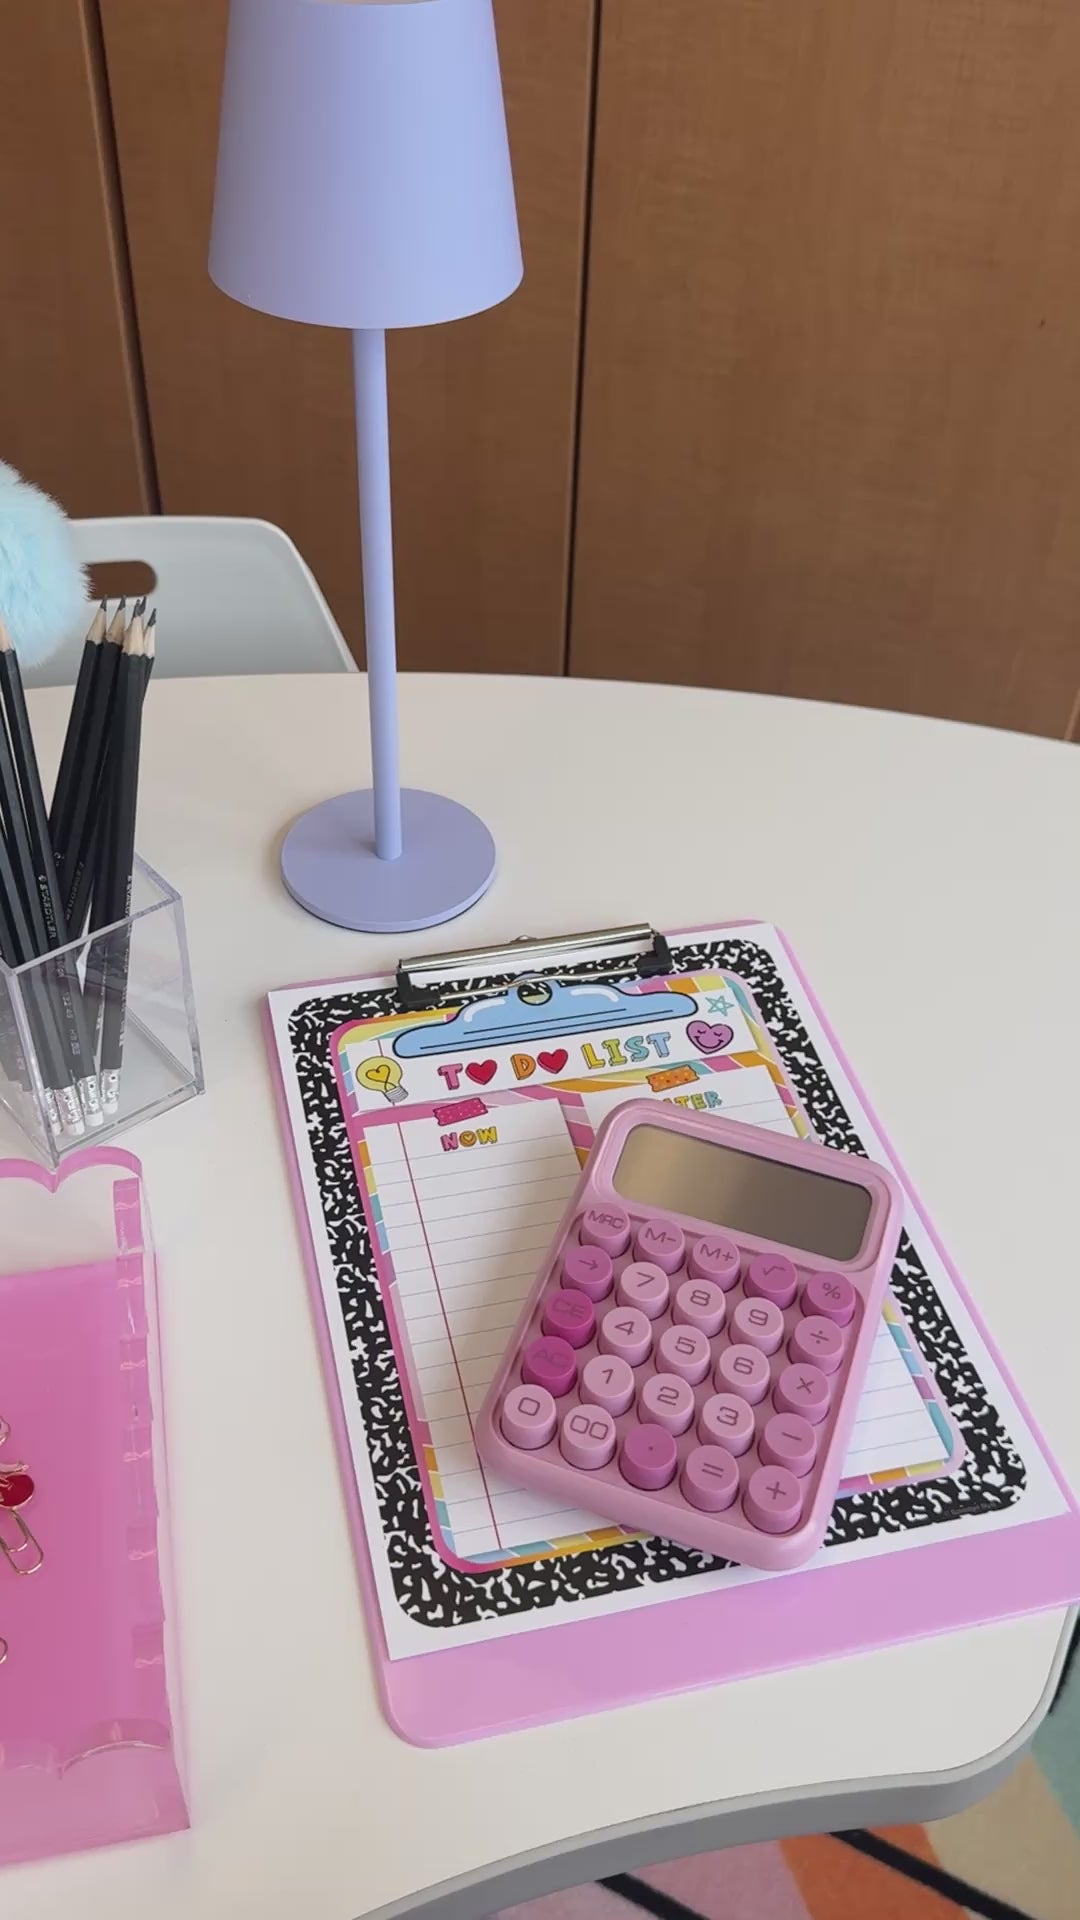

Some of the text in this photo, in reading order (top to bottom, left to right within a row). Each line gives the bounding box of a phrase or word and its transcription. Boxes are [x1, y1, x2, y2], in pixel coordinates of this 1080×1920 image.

[581, 1031, 671, 1069] LIST
[440, 1126, 498, 1151] NOW
[587, 1209, 625, 1230] MRC
[699, 1243, 734, 1262] M+
[636, 1271, 655, 1287] 7
[689, 1289, 711, 1307] 8
[821, 1281, 841, 1300] %
[552, 1299, 586, 1319] CE
[748, 1308, 769, 1326] 9
[615, 1320, 635, 1336] 4
[674, 1336, 697, 1355] 5
[533, 1350, 570, 1371] AC
[733, 1356, 754, 1375] 6
[601, 1368, 614, 1385] 1
[657, 1385, 680, 1406] 2
[517, 1396, 541, 1417] 0
[716, 1406, 740, 1427] 3
[569, 1414, 609, 1441] 00
